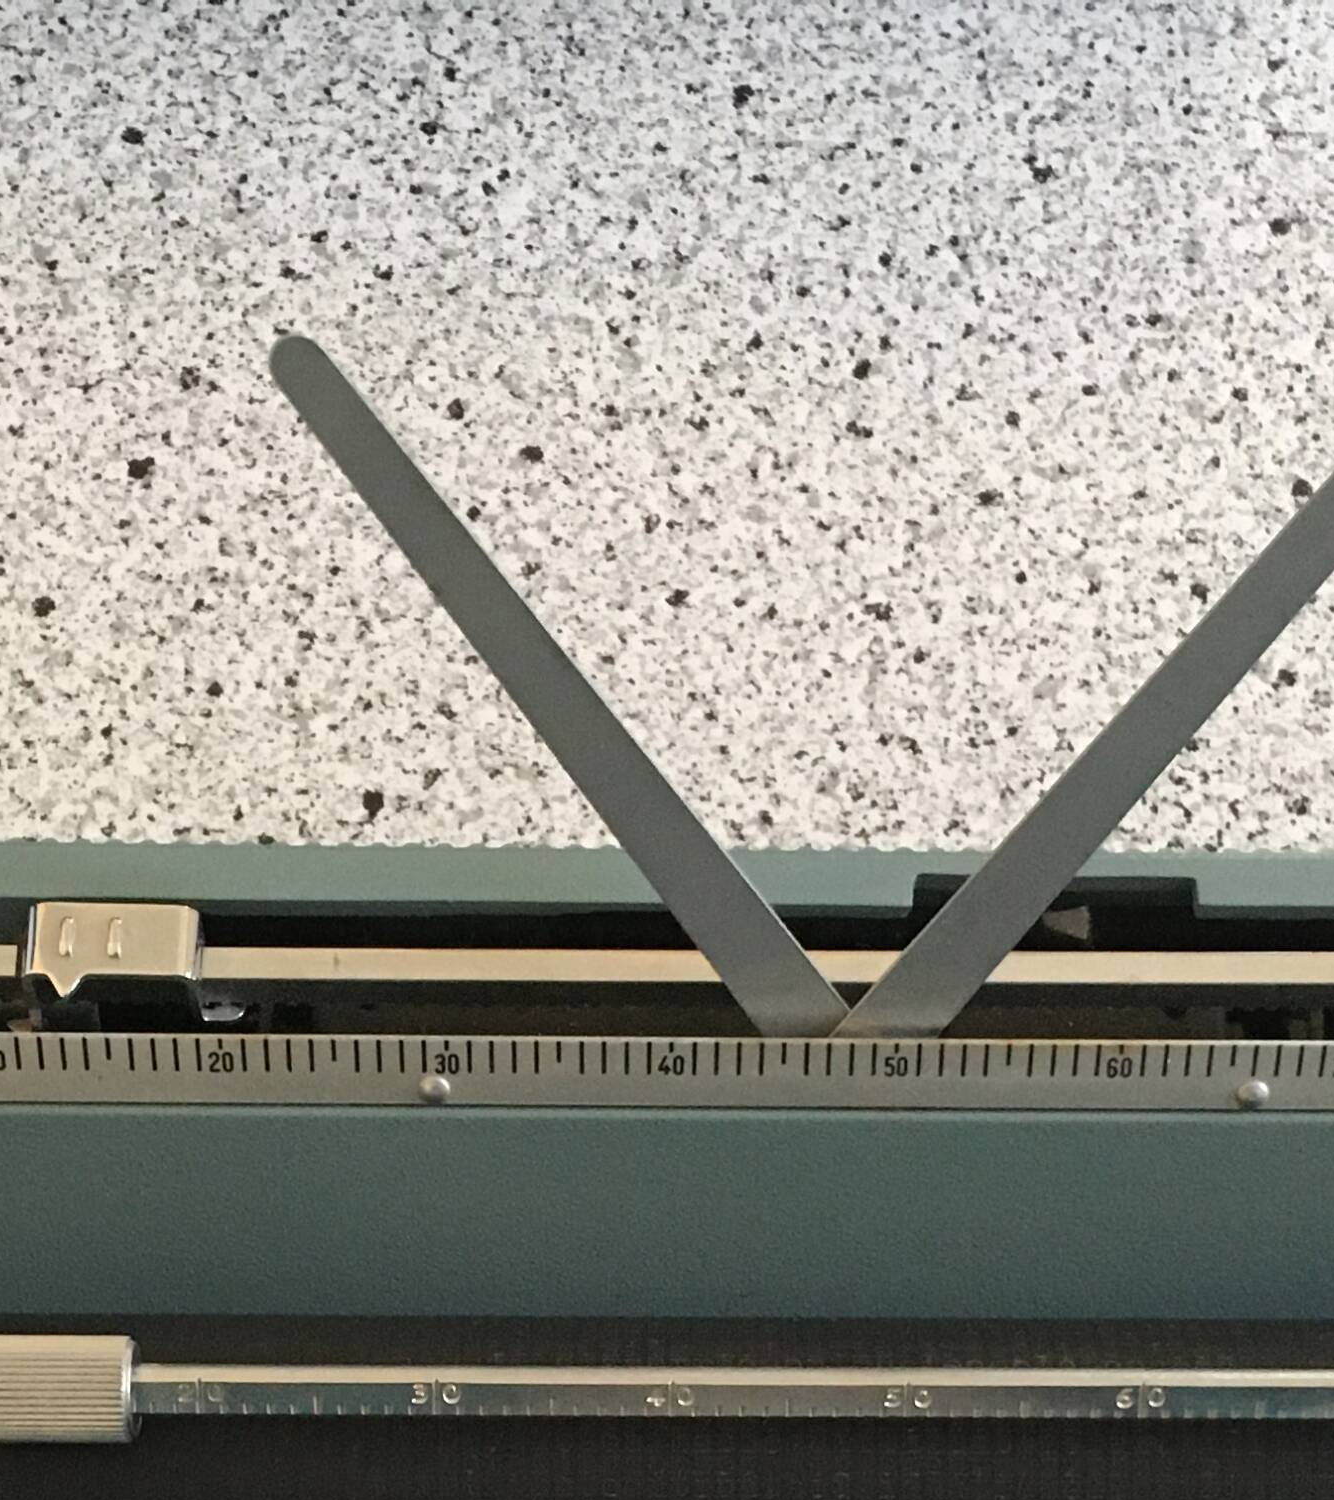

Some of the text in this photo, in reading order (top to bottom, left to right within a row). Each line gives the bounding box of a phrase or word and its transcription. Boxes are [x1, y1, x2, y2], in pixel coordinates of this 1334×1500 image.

[208, 1050, 234, 1073] 20
[434, 1053, 460, 1076] 30
[658, 1054, 685, 1077] 40
[884, 1056, 909, 1078] 50
[1106, 1057, 1132, 1079] 60
[1116, 1388, 1165, 1409] 60
